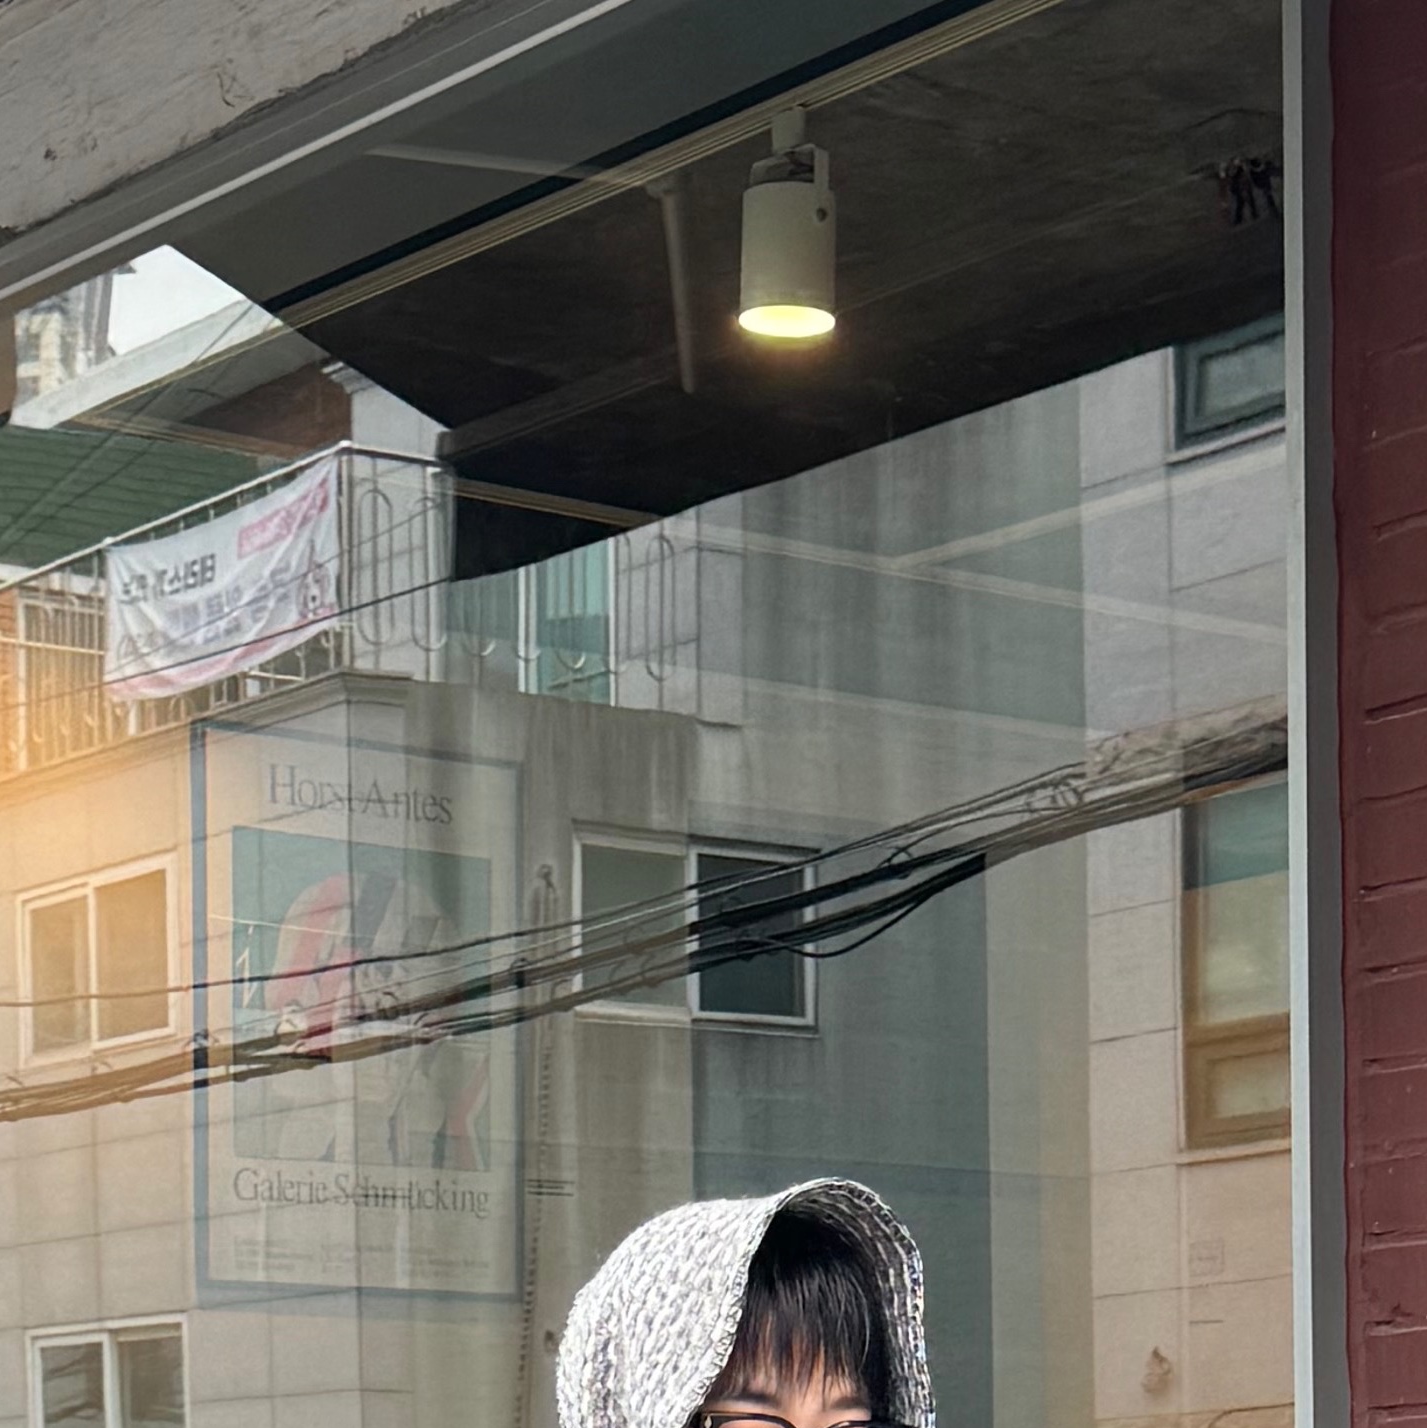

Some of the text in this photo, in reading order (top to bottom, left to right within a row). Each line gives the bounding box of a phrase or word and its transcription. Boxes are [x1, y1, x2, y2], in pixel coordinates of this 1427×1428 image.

[269, 763, 453, 825] Horst Antes
[233, 1167, 328, 1205] Galerie
